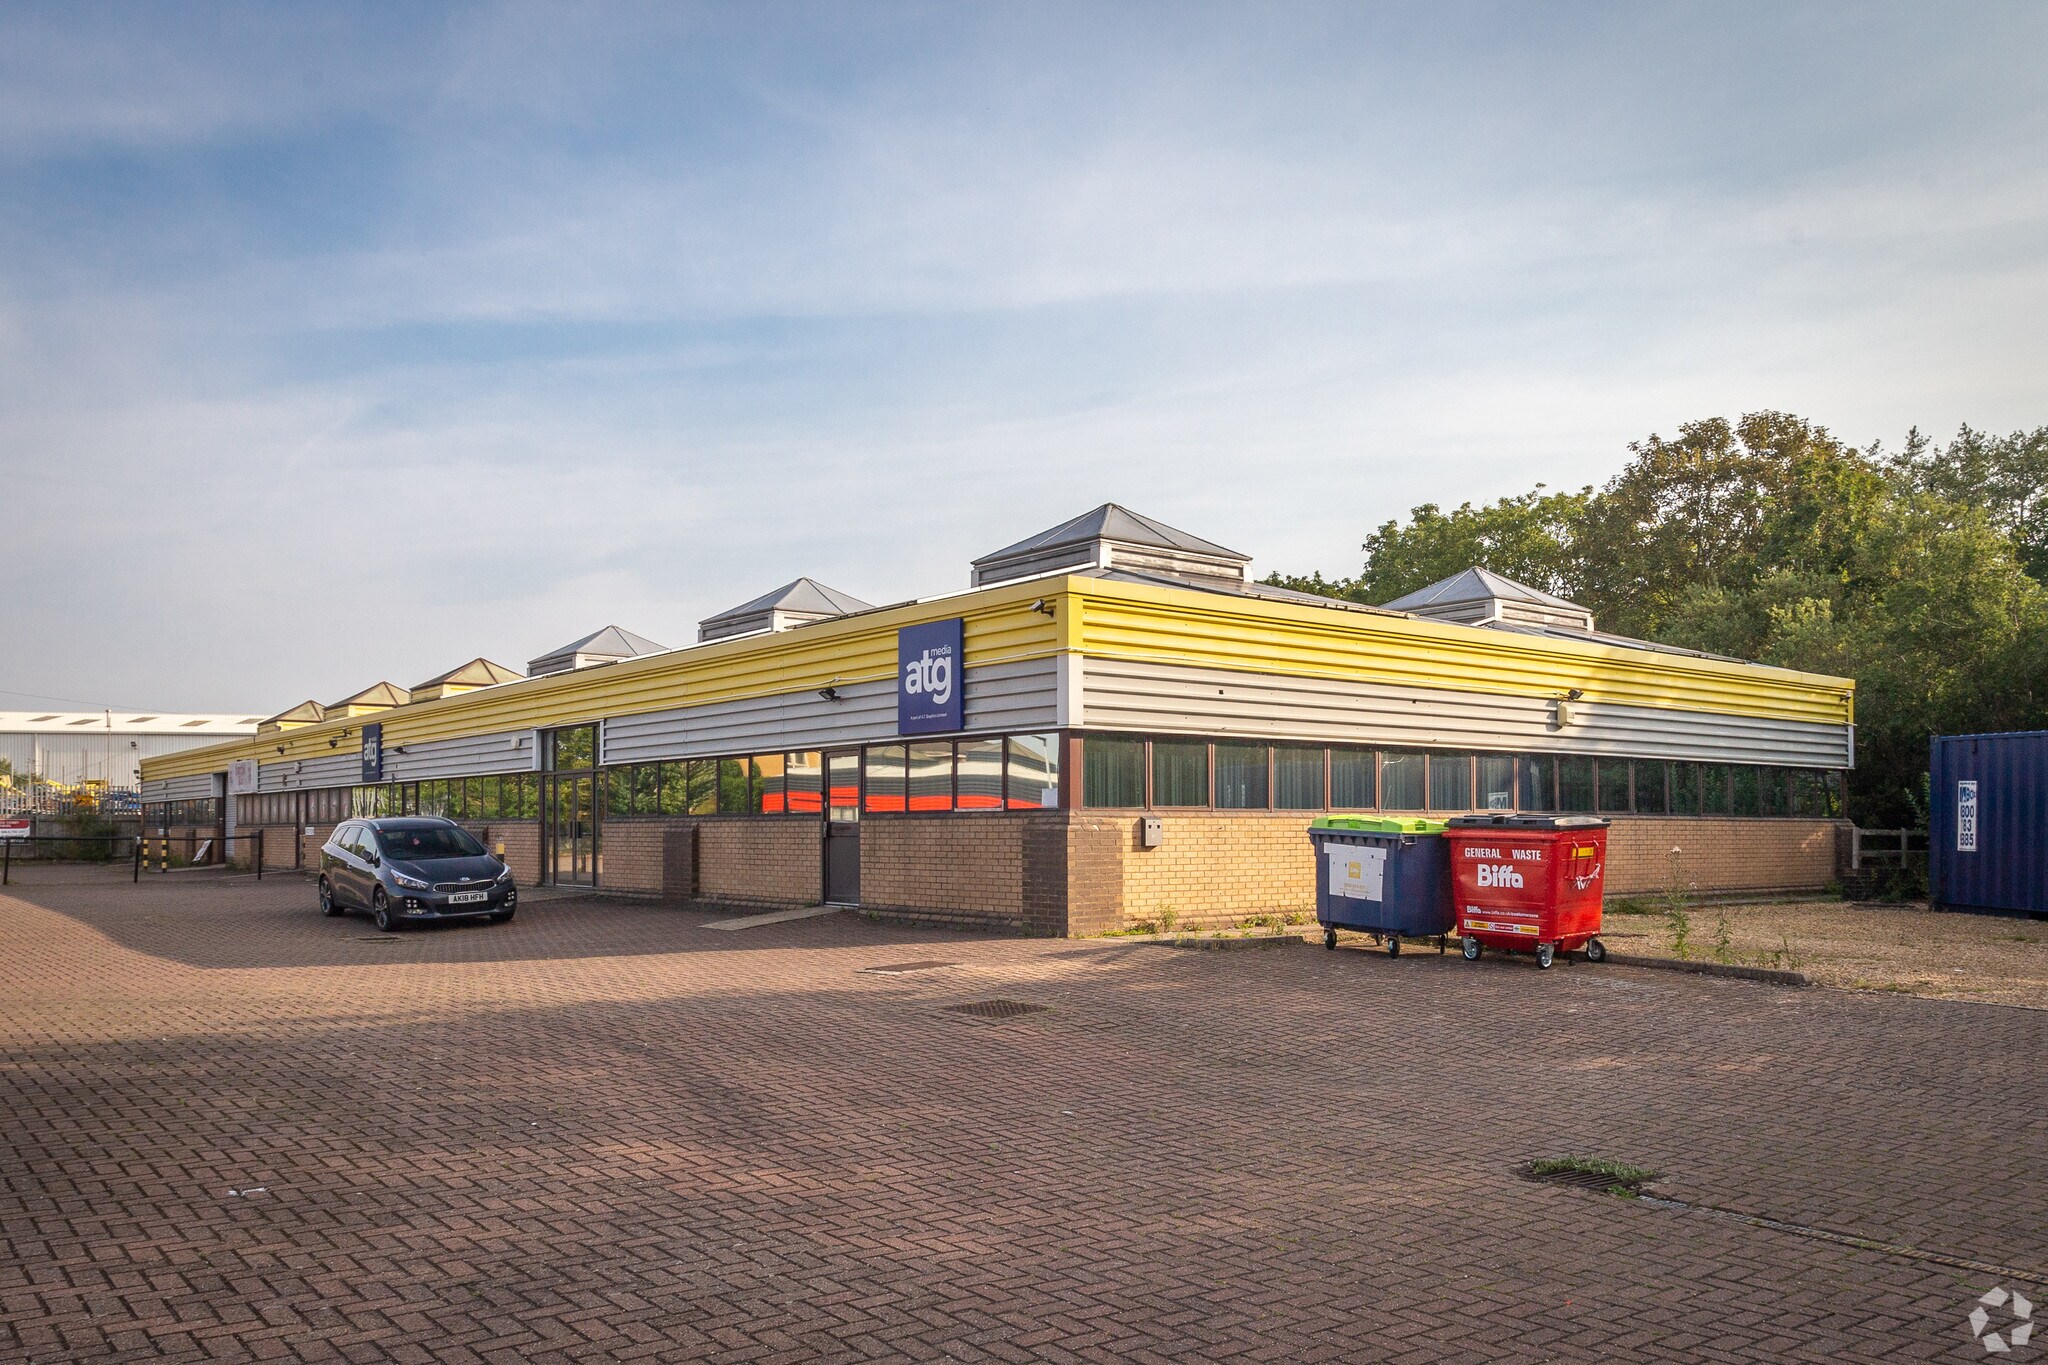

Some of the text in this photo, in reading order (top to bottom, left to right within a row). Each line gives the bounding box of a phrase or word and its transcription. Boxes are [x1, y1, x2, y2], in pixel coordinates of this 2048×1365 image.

[931, 644, 951, 656] media
[905, 650, 951, 704] atg
[364, 737, 376, 767] atg
[1465, 848, 1541, 860] GENERAL WASTE
[1478, 864, 1523, 888] Biffa
